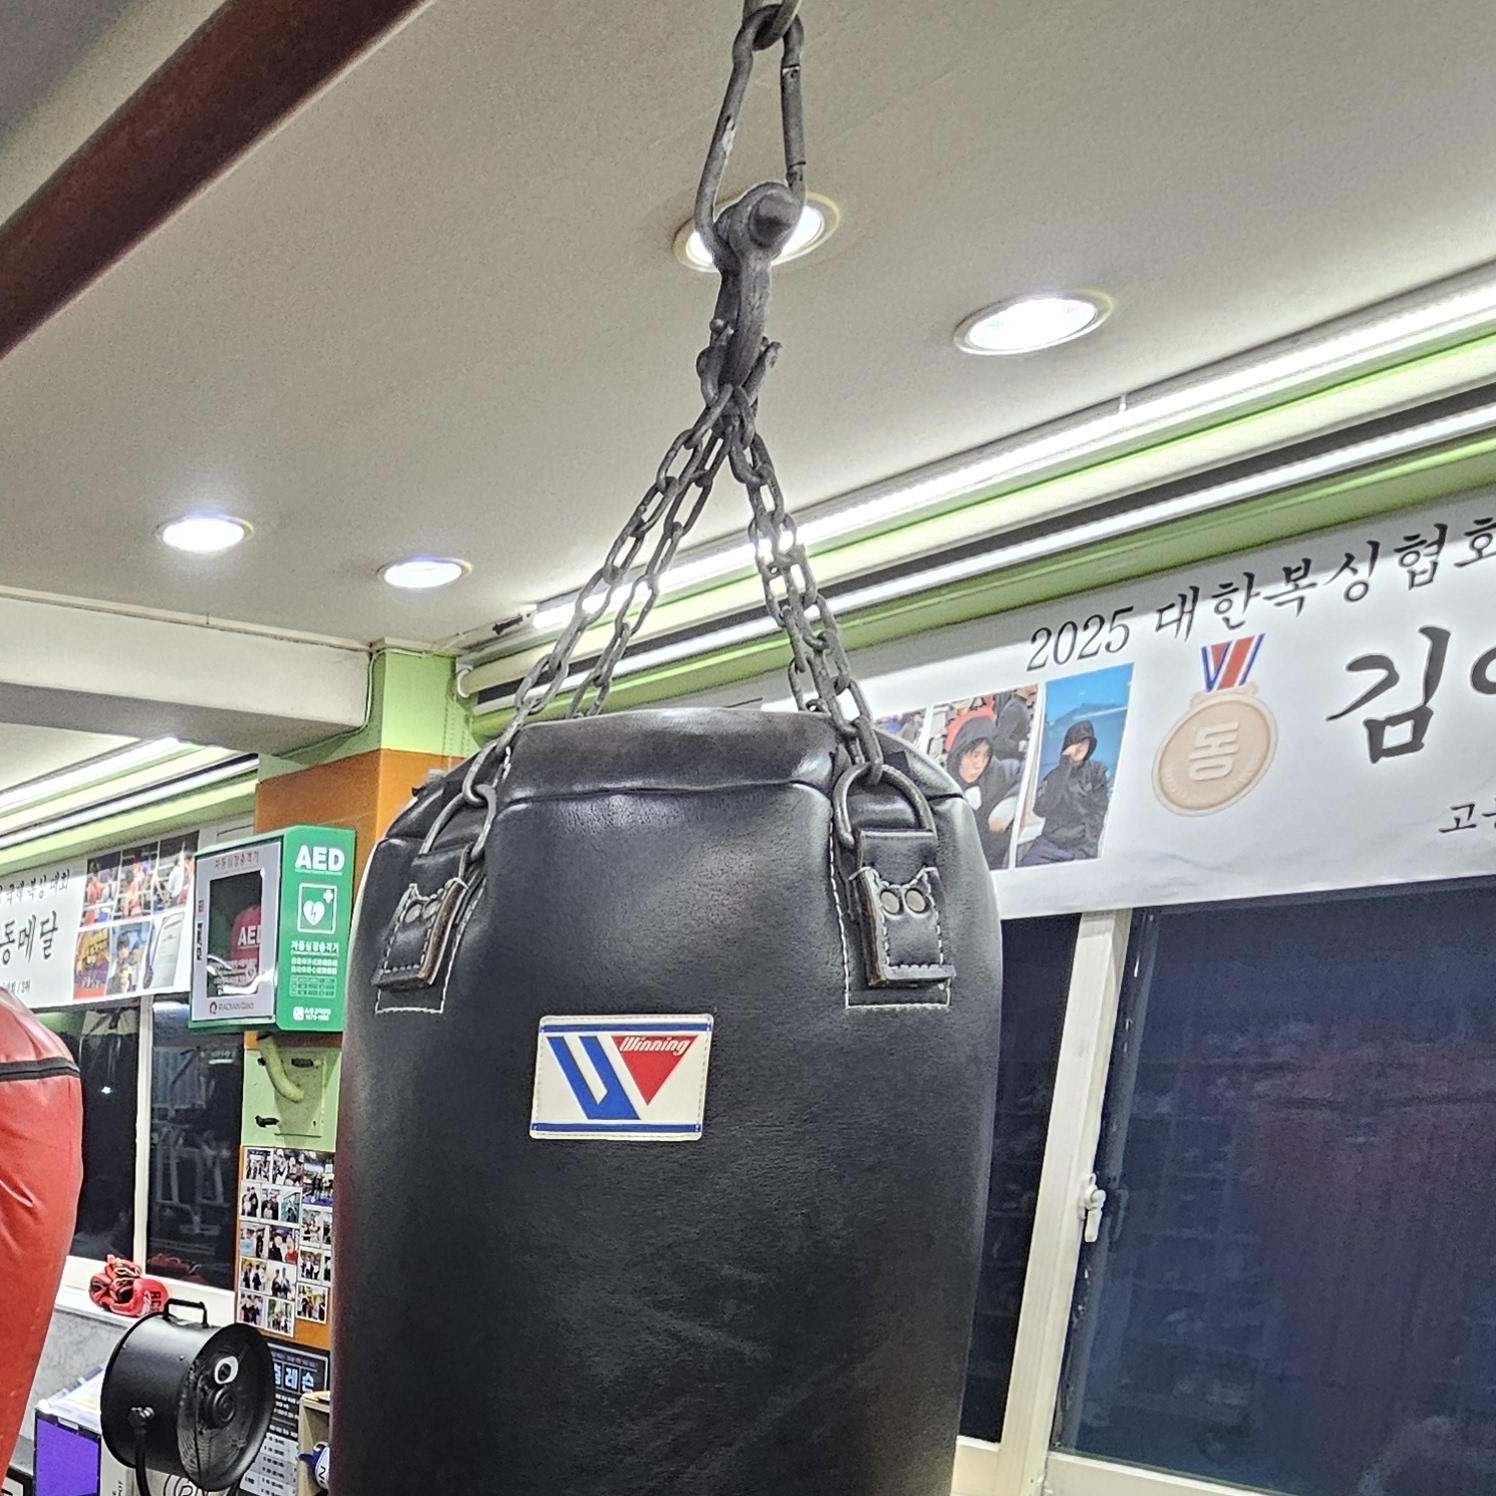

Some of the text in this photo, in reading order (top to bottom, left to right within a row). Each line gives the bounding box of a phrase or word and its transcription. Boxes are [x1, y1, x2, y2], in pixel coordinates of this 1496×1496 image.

[1026, 606, 1135, 672] 2025
[1325, 626, 1496, 765] 김
[295, 845, 345, 872] AED
[619, 1036, 691, 1056] Winning
